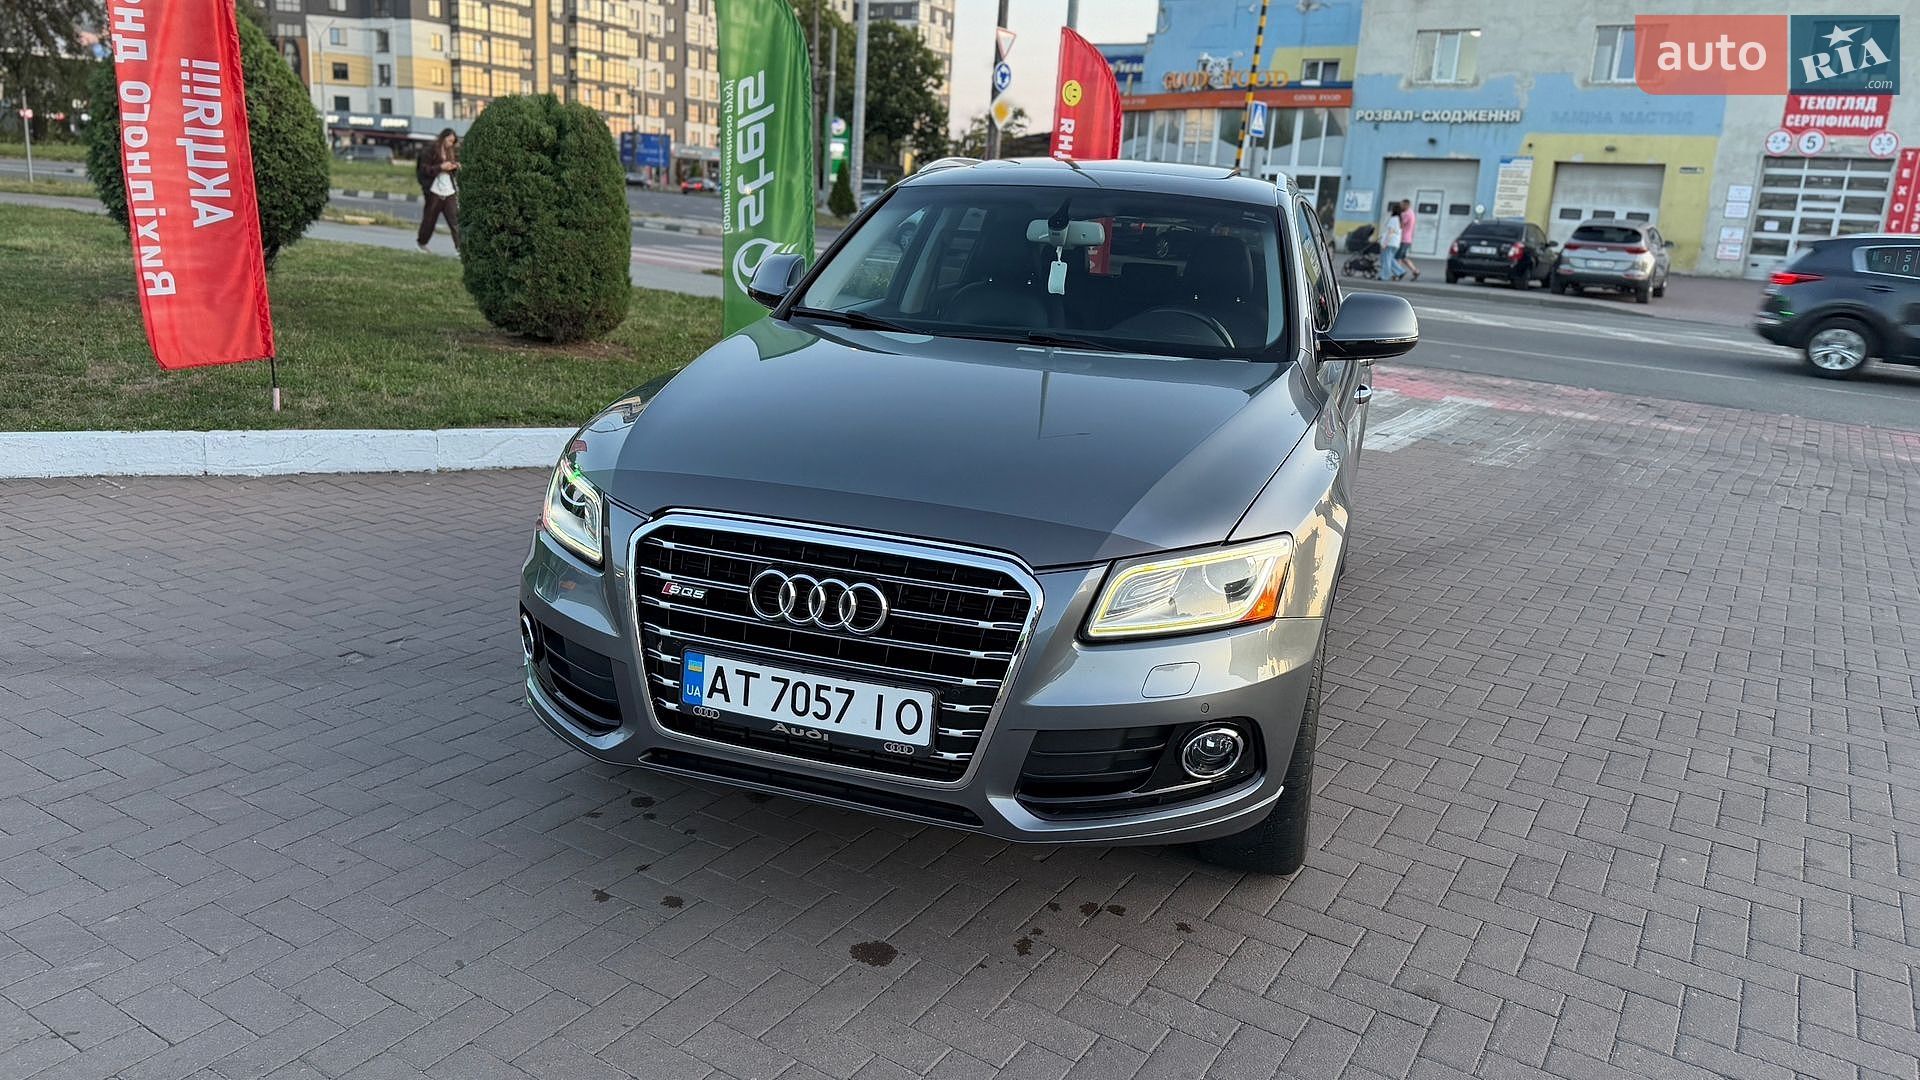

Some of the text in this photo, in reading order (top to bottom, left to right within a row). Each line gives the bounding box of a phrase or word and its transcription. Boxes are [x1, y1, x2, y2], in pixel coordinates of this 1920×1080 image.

[1800, 96, 1878, 112] ТЕХОГЛЯД
[1785, 114, 1885, 130] СЕРТИФІКАЦІЯ
[1805, 136, 1817, 149] 5
[662, 582, 705, 599] SQ5
[687, 684, 701, 696] UA
[707, 665, 761, 706] AT
[770, 675, 855, 724] 7057
[770, 722, 829, 741] Audi
